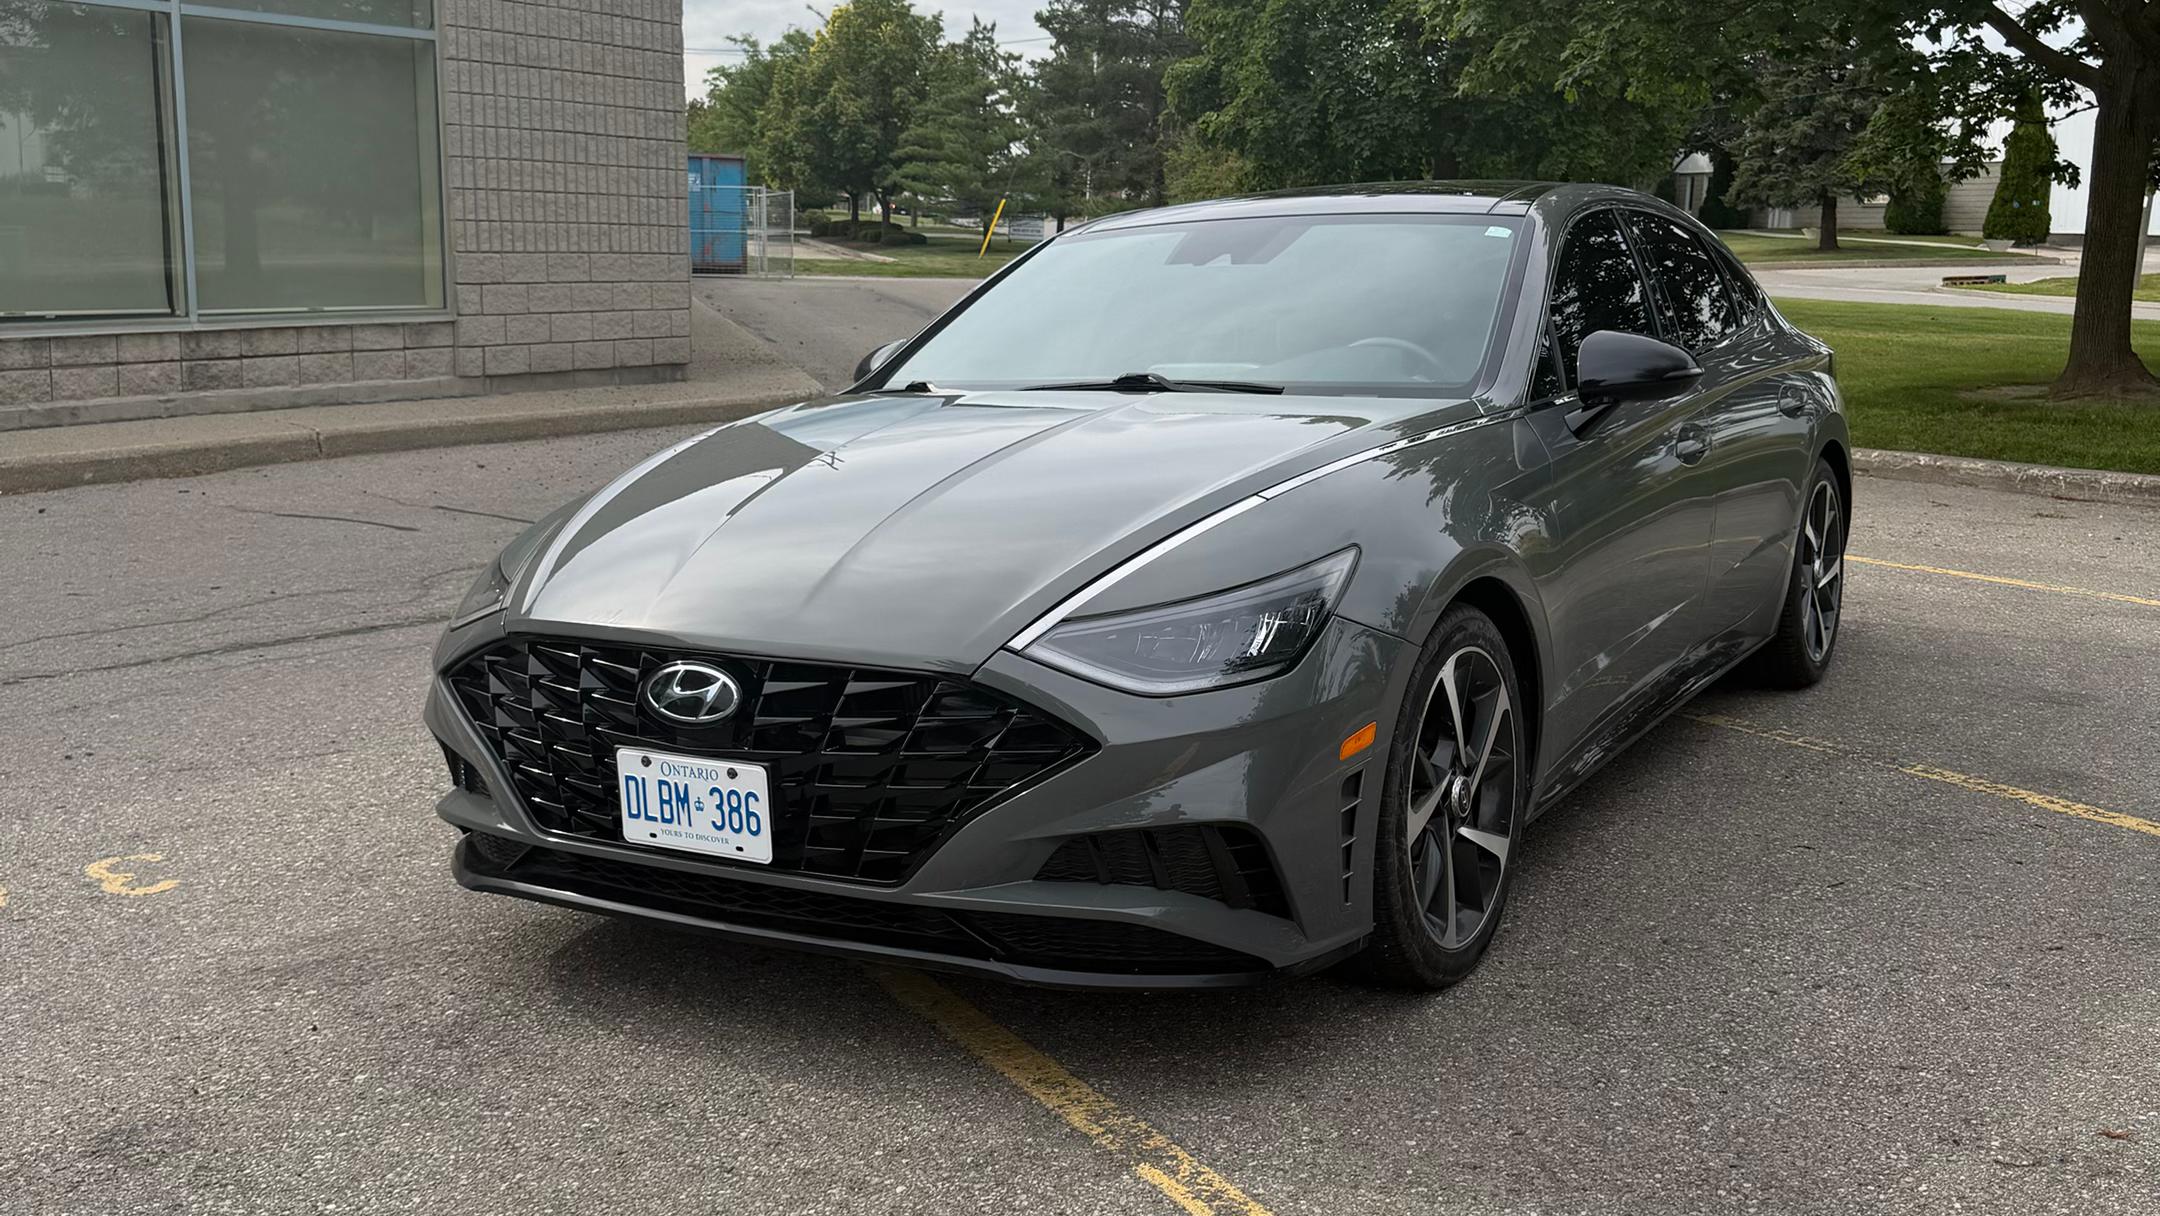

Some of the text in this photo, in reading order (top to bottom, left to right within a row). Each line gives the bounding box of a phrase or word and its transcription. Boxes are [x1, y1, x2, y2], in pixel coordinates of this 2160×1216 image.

[660, 761, 719, 782] ONTARIO
[624, 774, 762, 837] DLBM 386
[684, 832, 695, 840] TO
[695, 833, 730, 845] DISCOVER
